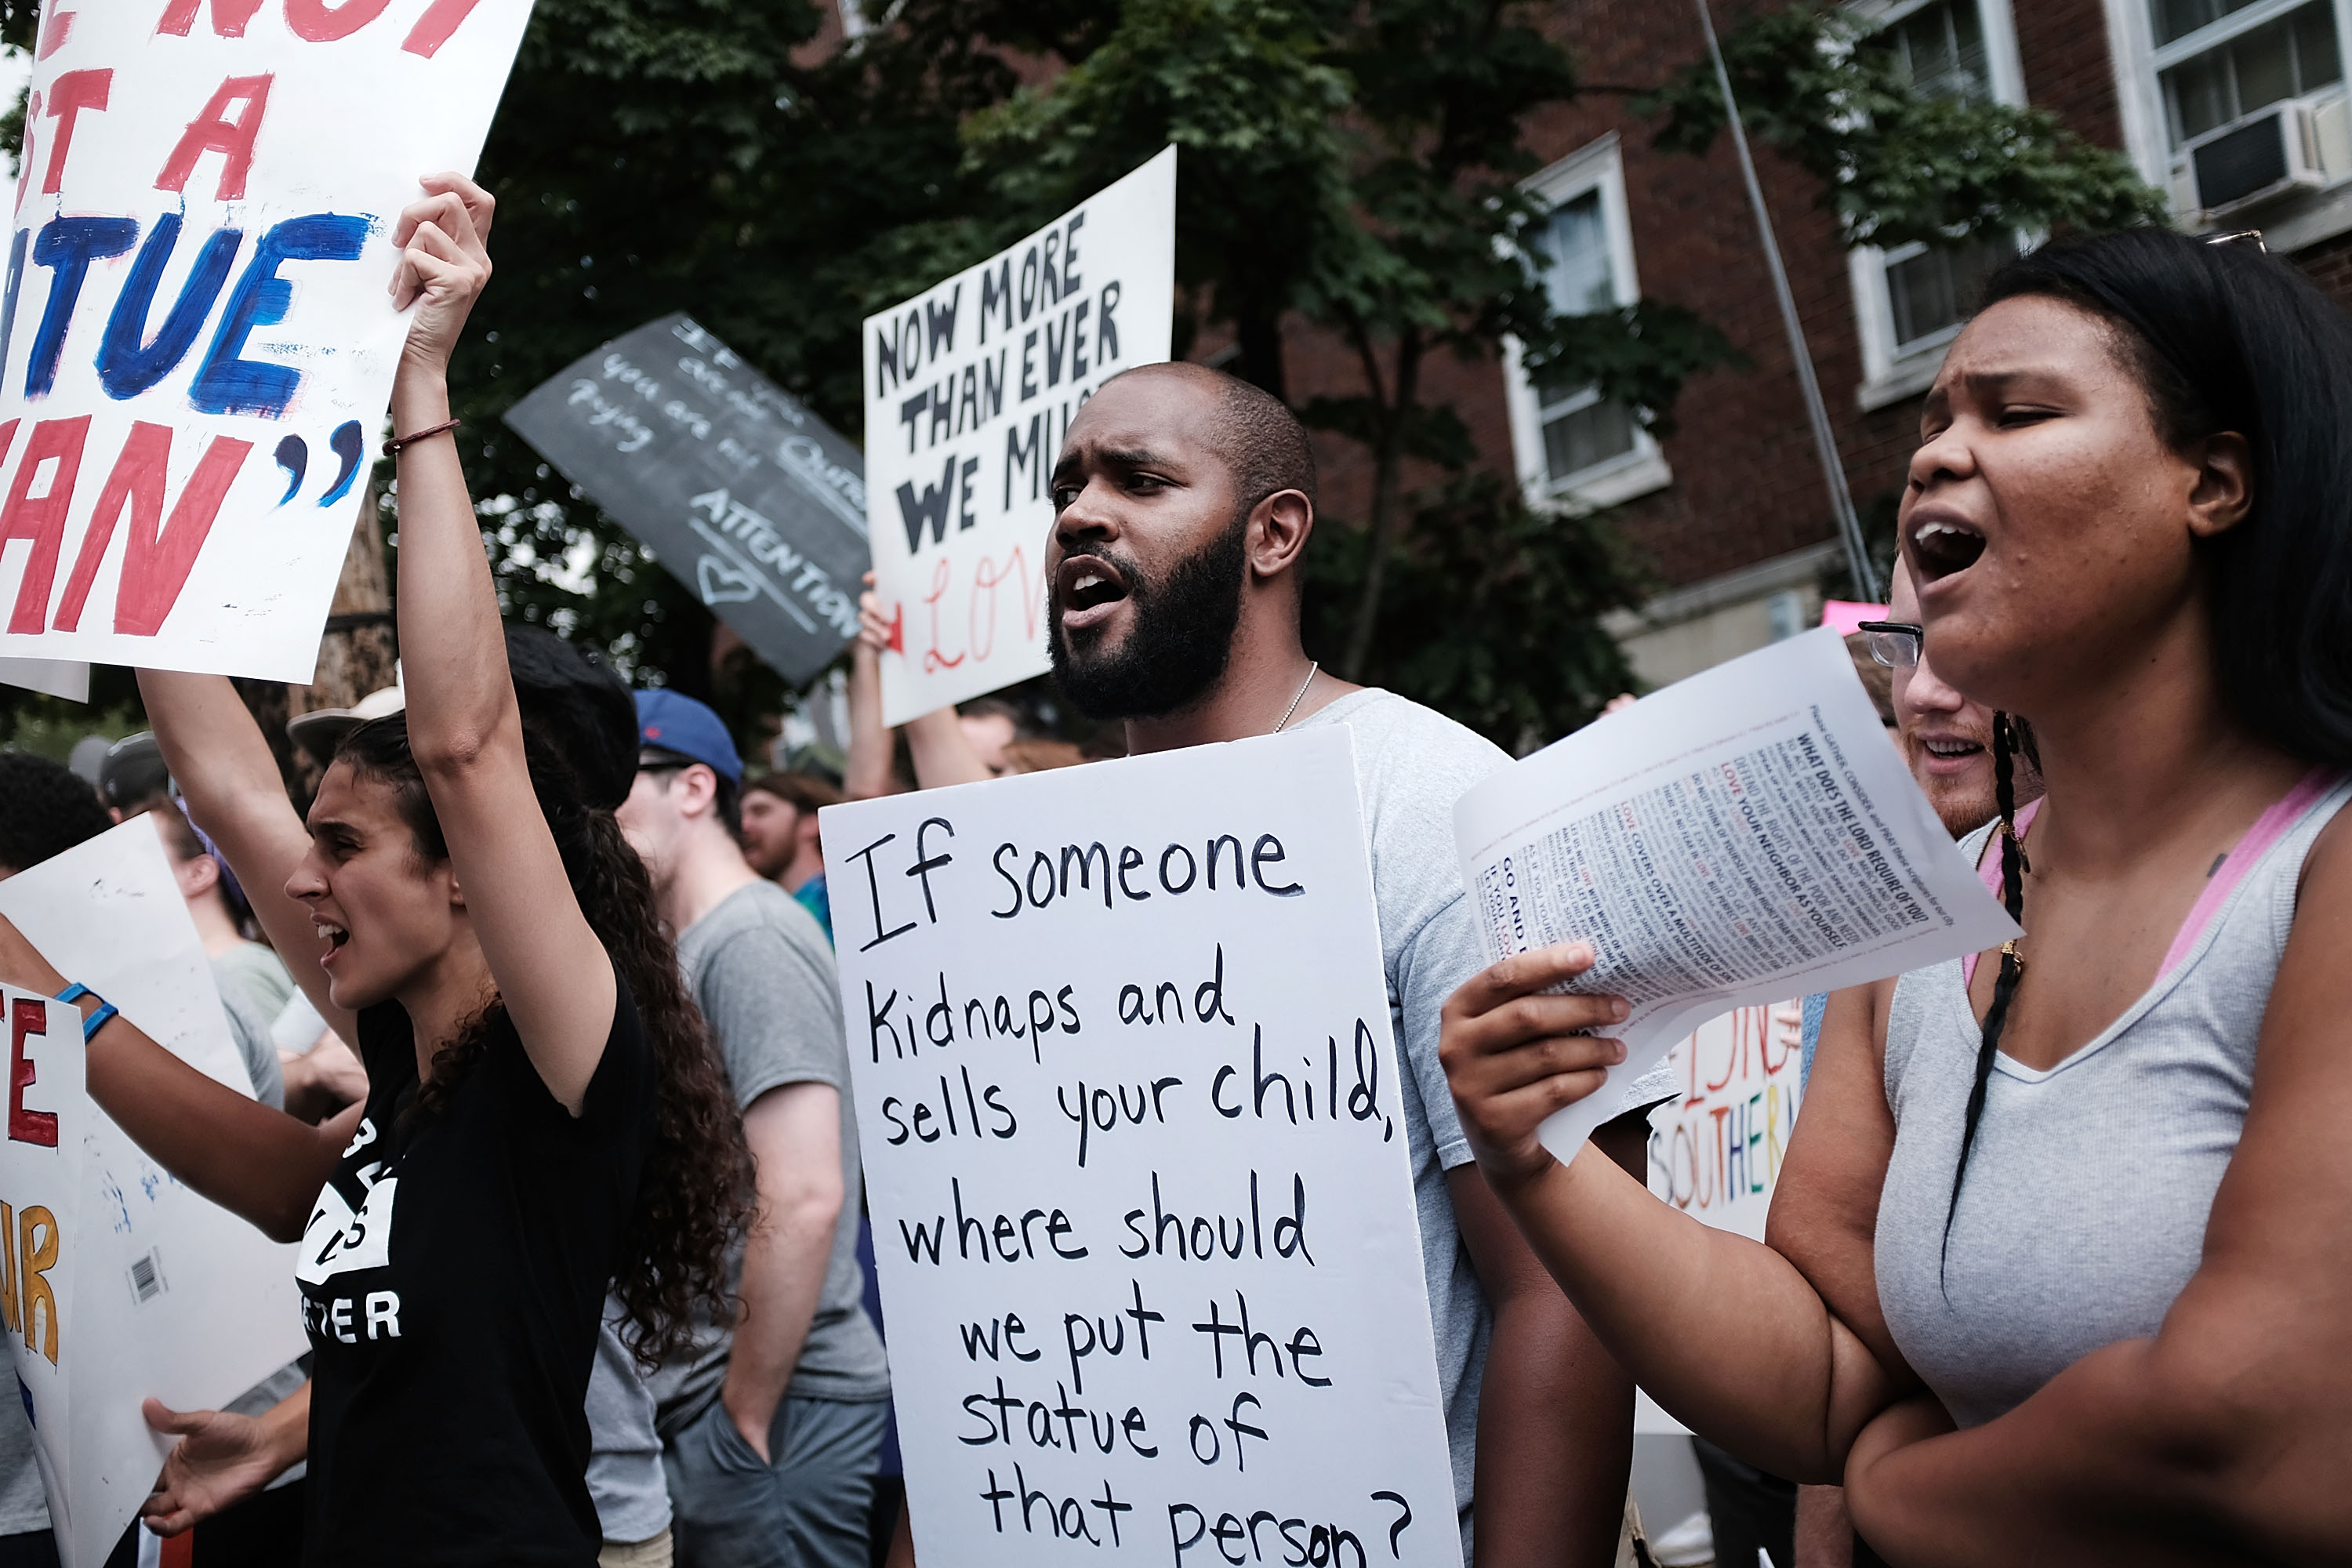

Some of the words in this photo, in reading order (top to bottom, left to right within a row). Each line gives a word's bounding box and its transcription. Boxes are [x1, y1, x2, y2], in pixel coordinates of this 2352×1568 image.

[152, 69, 275, 201] A
[877, 283, 960, 398] NOW
[980, 211, 1086, 346] MORE
[901, 348, 1006, 455] THAN
[1021, 281, 1121, 403] EVER
[689, 488, 862, 639] ATTENTION
[896, 455, 978, 555] WE
[924, 545, 1047, 673] LOV
[1570, 823, 1578, 836] LET
[1573, 838, 1580, 848] US
[1576, 850, 1585, 866] NOT
[1691, 773, 1700, 785] DO
[1697, 786, 1710, 802] NOT
[1706, 804, 1721, 828] THINK
[1716, 829, 1728, 838] OF
[1724, 840, 1750, 875] YOURSELF
[1745, 877, 1762, 896] MORE
[1759, 897, 1779, 919] HIGHLY
[1775, 918, 1791, 935] THAN
[1788, 934, 1800, 945] YOU
[1721, 762, 1742, 795] LOVE
[1738, 797, 1762, 833] YOUR
[1758, 834, 1801, 893] NEIGHBOR
[1795, 894, 1812, 907] AS
[1807, 907, 1847, 949] YOURSELF.
[1734, 757, 1761, 797] DEFEND
[1755, 797, 1772, 816] THE
[1766, 818, 1792, 853] RIGHTS
[1787, 854, 1803, 866] OF
[1796, 866, 1814, 884] THE
[1808, 884, 1831, 908] POOR
[1824, 909, 1844, 924] AND
[1758, 750, 1772, 774] SPEAK
[1777, 788, 1788, 803] FOR
[1787, 804, 1802, 827] THOSE
[1800, 828, 1813, 845] WHO
[1812, 847, 1833, 873] CANNOT
[1831, 874, 1846, 894] SPEAK
[1845, 894, 1857, 906] FOR
[1776, 742, 1797, 777] HUMBLY
[1795, 781, 1810, 802] WITH
[1809, 804, 1826, 826] YOUR
[1837, 849, 1849, 861] DO
[1846, 862, 1861, 877] NOT
[1858, 880, 1887, 913] WITHHOLD
[1884, 913, 1901, 930] GOOD
[1787, 739, 1797, 751] TO
[1794, 755, 1808, 771] ACT
[1804, 776, 1824, 802] JUSTLY
[1823, 807, 1838, 824] AND
[1835, 826, 1846, 837] TO
[1843, 840, 1860, 857] LOVE
[1858, 860, 1878, 884] MERCY
[1876, 887, 1891, 901] AND
[1889, 902, 1899, 910] TO
[1798, 733, 1824, 768] WHAT
[1816, 770, 1842, 800] DOES
[1835, 800, 1855, 822] THE
[1847, 822, 1874, 850] LORD
[1867, 850, 1904, 892] REQUIRE
[1895, 891, 1913, 902] OF
[1904, 902, 1929, 922] YOU?
[1809, 705, 1826, 732] Please
[1869, 814, 1884, 828] and
[1881, 828, 1896, 846] PRAY
[1893, 847, 1909, 866] these
[1906, 868, 1931, 898] scriptures
[846, 817, 955, 952] If
[991, 832, 1305, 918] someone
[1494, 885, 1504, 924] YOU
[1504, 857, 1514, 887] GO
[1509, 896, 1523, 939] AND
[1528, 844, 1536, 858] AS
[1534, 874, 1543, 898] YOU
[1581, 868, 1592, 886] LOVE
[1588, 888, 1600, 909] WITH
[1597, 910, 1614, 938] WORDS
[1621, 801, 1635, 829] LOVE
[1632, 833, 1654, 877] COVERS
[1652, 878, 1672, 908] OVER
[1674, 918, 1715, 964] MULTITUDE
[1663, 785, 1675, 808] THERE
[1675, 818, 1684, 829] NO
[1682, 831, 1693, 849] FEAR
[1707, 880, 1721, 894] BUT
[1717, 895, 1739, 920] PERFECT
[1734, 921, 1750, 935] LOVE
[1744, 935, 1763, 953] DRIVES
[1672, 781, 1698, 827] WITHOUT
[1694, 831, 1728, 884] EXPECTING
[1724, 884, 1737, 897] TO
[1733, 899, 1750, 915] GET
[1746, 918, 1778, 952] ANYTHING
[1117, 942, 1236, 1026] and
[1611, 939, 1621, 950] OR
[1618, 951, 1639, 975] SPEECH
[882, 1064, 1018, 1145] sells
[1058, 1076, 1183, 1167] your
[1211, 1018, 1394, 1142] child,
[898, 1177, 1089, 1267] where
[1118, 1170, 1315, 1267] should
[960, 1312, 1042, 1363] we
[1064, 1279, 1165, 1395] put
[1192, 1290, 1333, 1388] the
[957, 1376, 1159, 1458] statue
[1190, 1392, 1269, 1472] of
[980, 1463, 1133, 1548] that
[1168, 1490, 1413, 1568] person?
